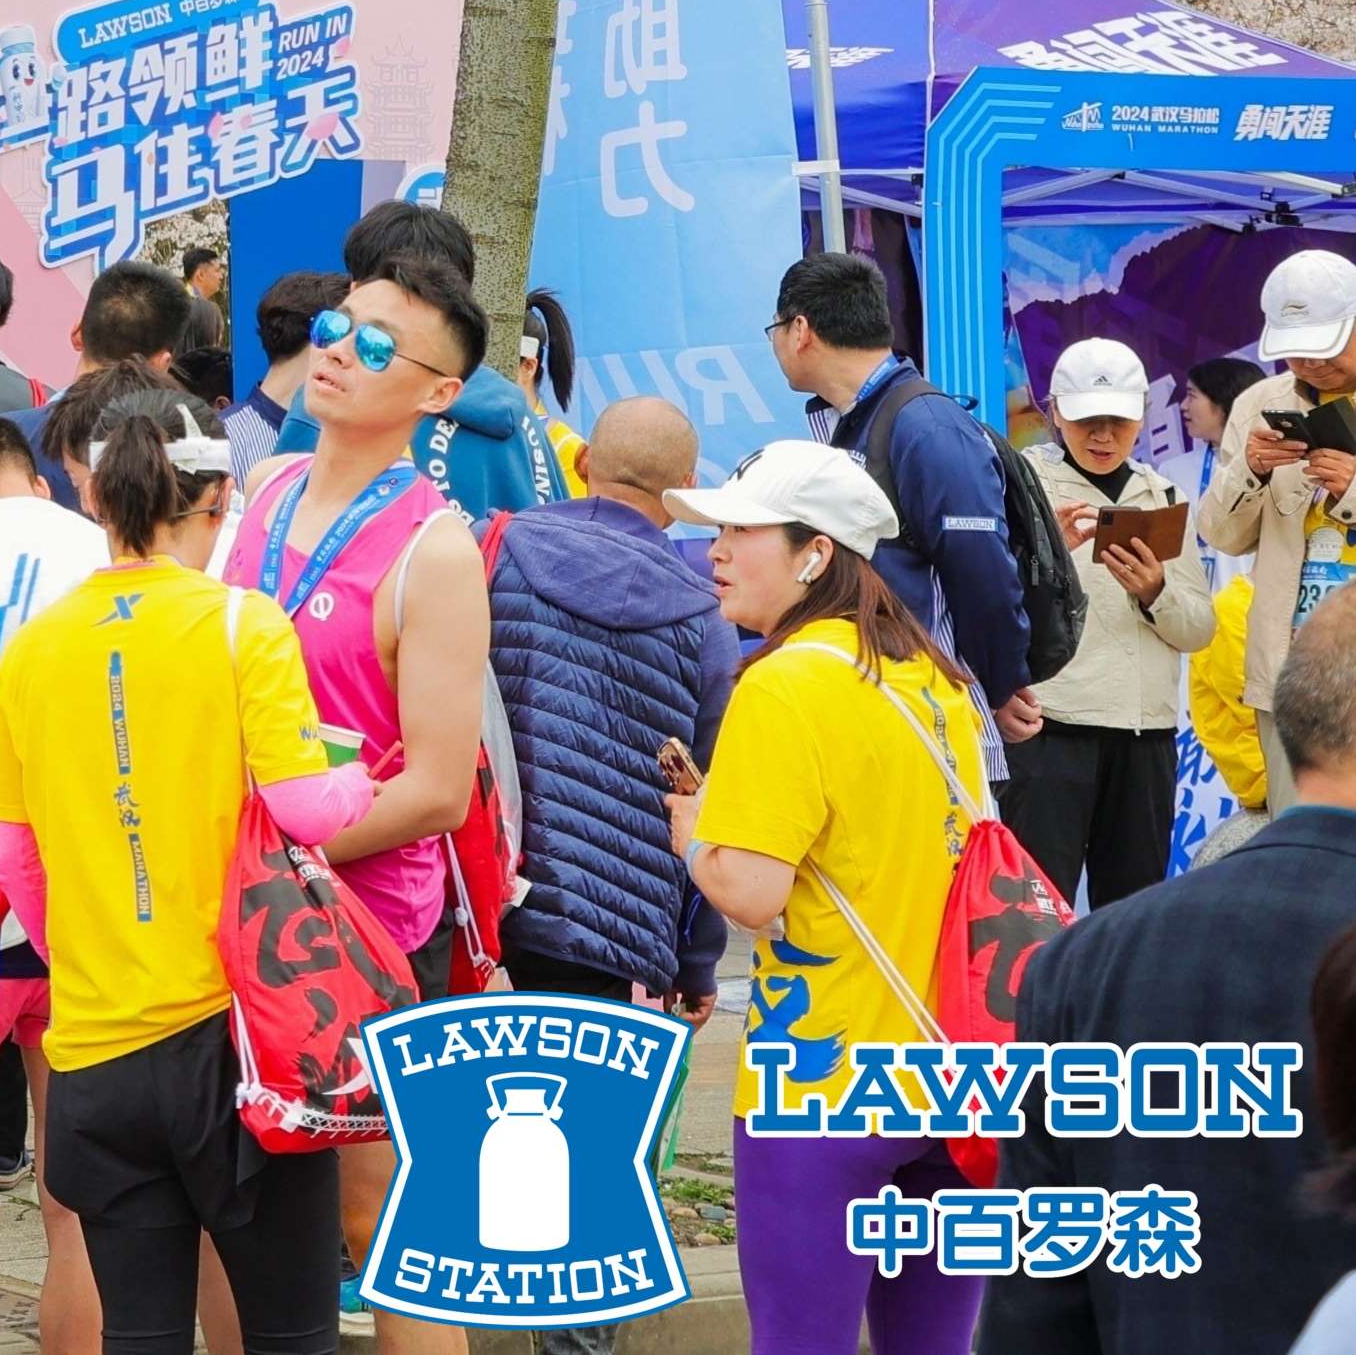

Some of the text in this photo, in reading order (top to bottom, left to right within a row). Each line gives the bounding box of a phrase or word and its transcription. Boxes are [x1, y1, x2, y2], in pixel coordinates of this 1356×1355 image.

[79, 4, 172, 49] LAWSON
[278, 12, 348, 53] RUN IN
[276, 48, 325, 81] 2024
[1112, 124, 1152, 133] WUHAN
[1158, 125, 1219, 135] MARATHON
[1233, 104, 1335, 141] 勇闯天涯
[50, 76, 355, 270] 马住春天
